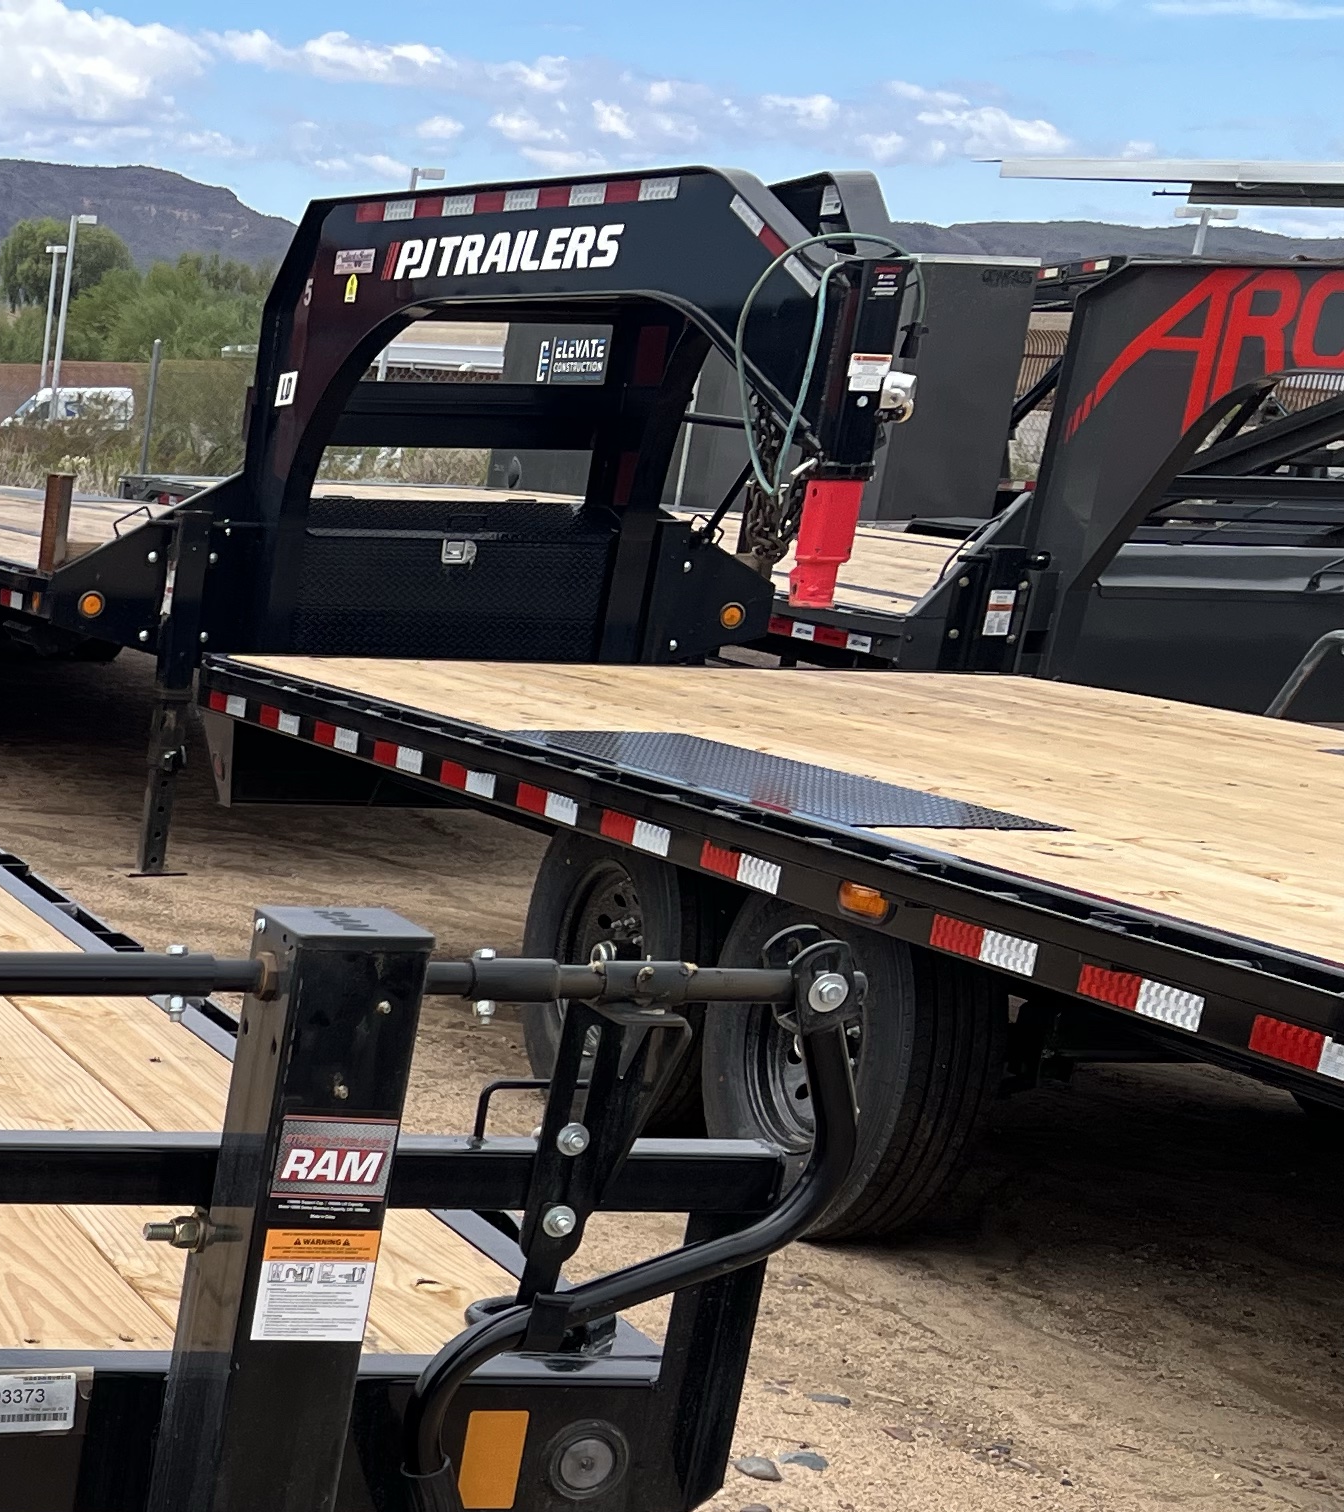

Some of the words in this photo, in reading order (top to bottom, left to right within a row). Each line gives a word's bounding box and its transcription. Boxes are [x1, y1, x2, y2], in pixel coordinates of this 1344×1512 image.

[393, 237, 438, 281] PJ
[436, 223, 625, 278] TRAILERS
[555, 338, 606, 358] ELEVATE
[1066, 268, 1344, 440] ARC
[553, 361, 604, 373] CONSTRUCTION
[280, 1148, 384, 1183] RAM
